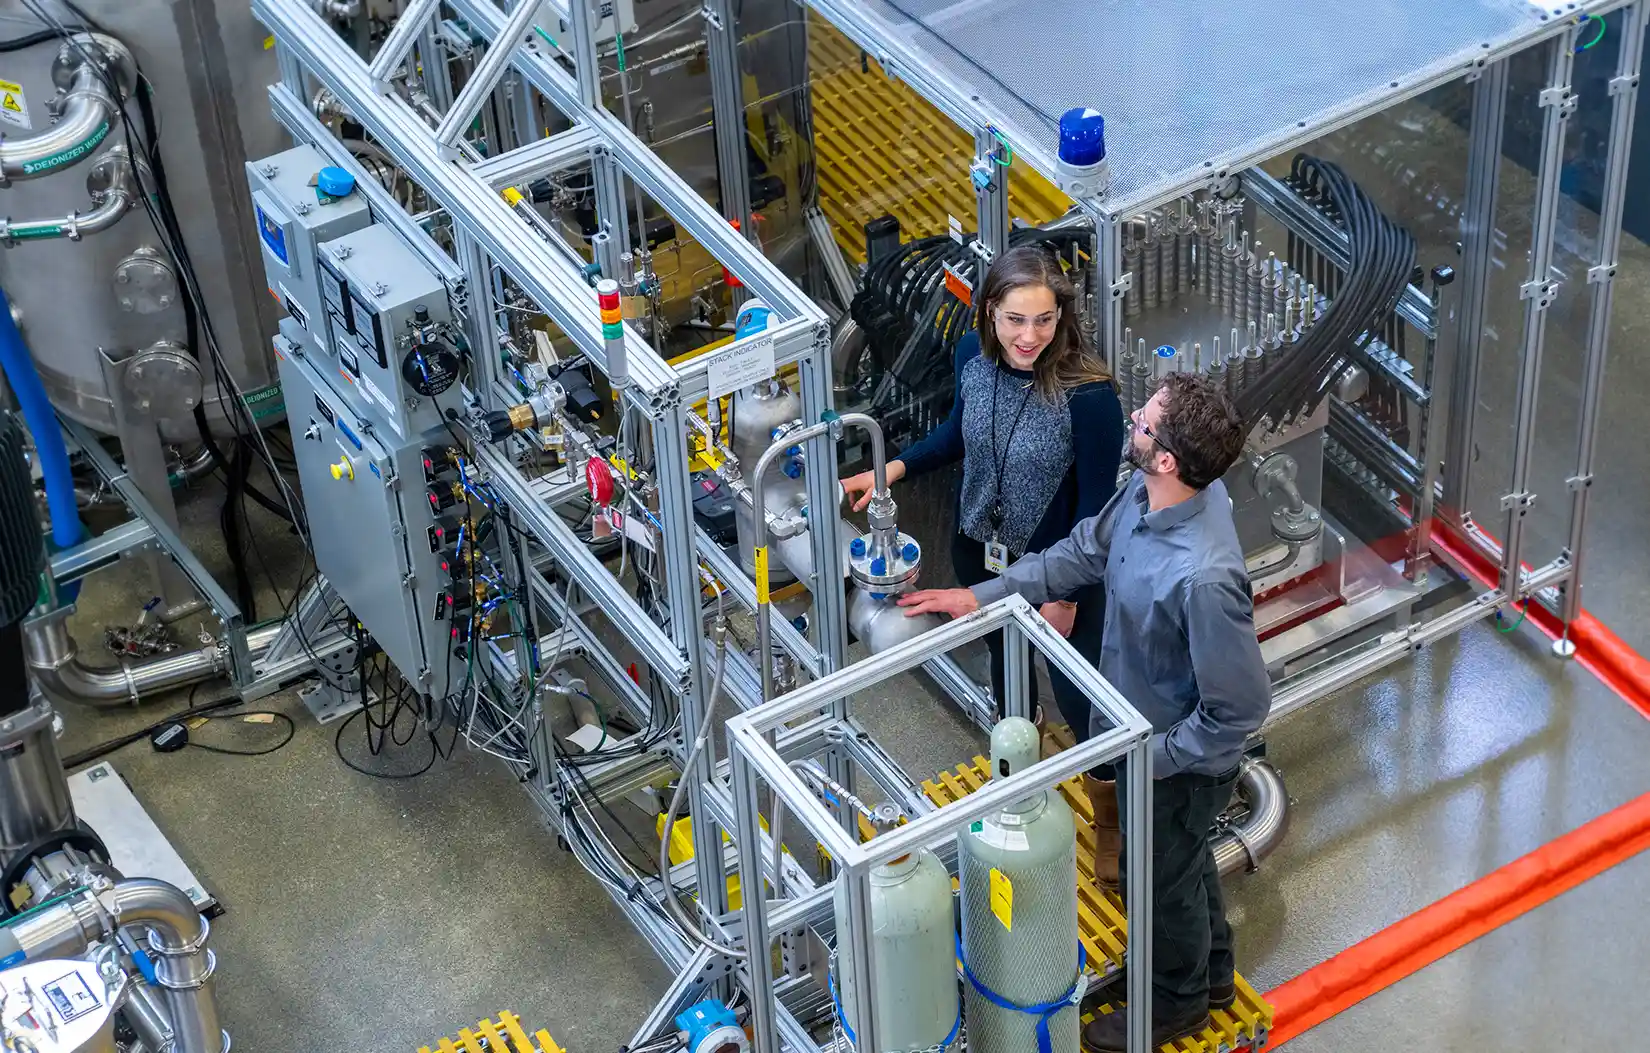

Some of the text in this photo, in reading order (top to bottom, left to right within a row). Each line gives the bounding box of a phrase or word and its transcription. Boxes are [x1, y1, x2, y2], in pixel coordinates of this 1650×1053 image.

[33, 127, 107, 171] DEIONIZED WATER
[709, 353, 733, 367] STACK
[733, 338, 772, 357] INDICATOR
[246, 387, 278, 403] DEIONIZED
